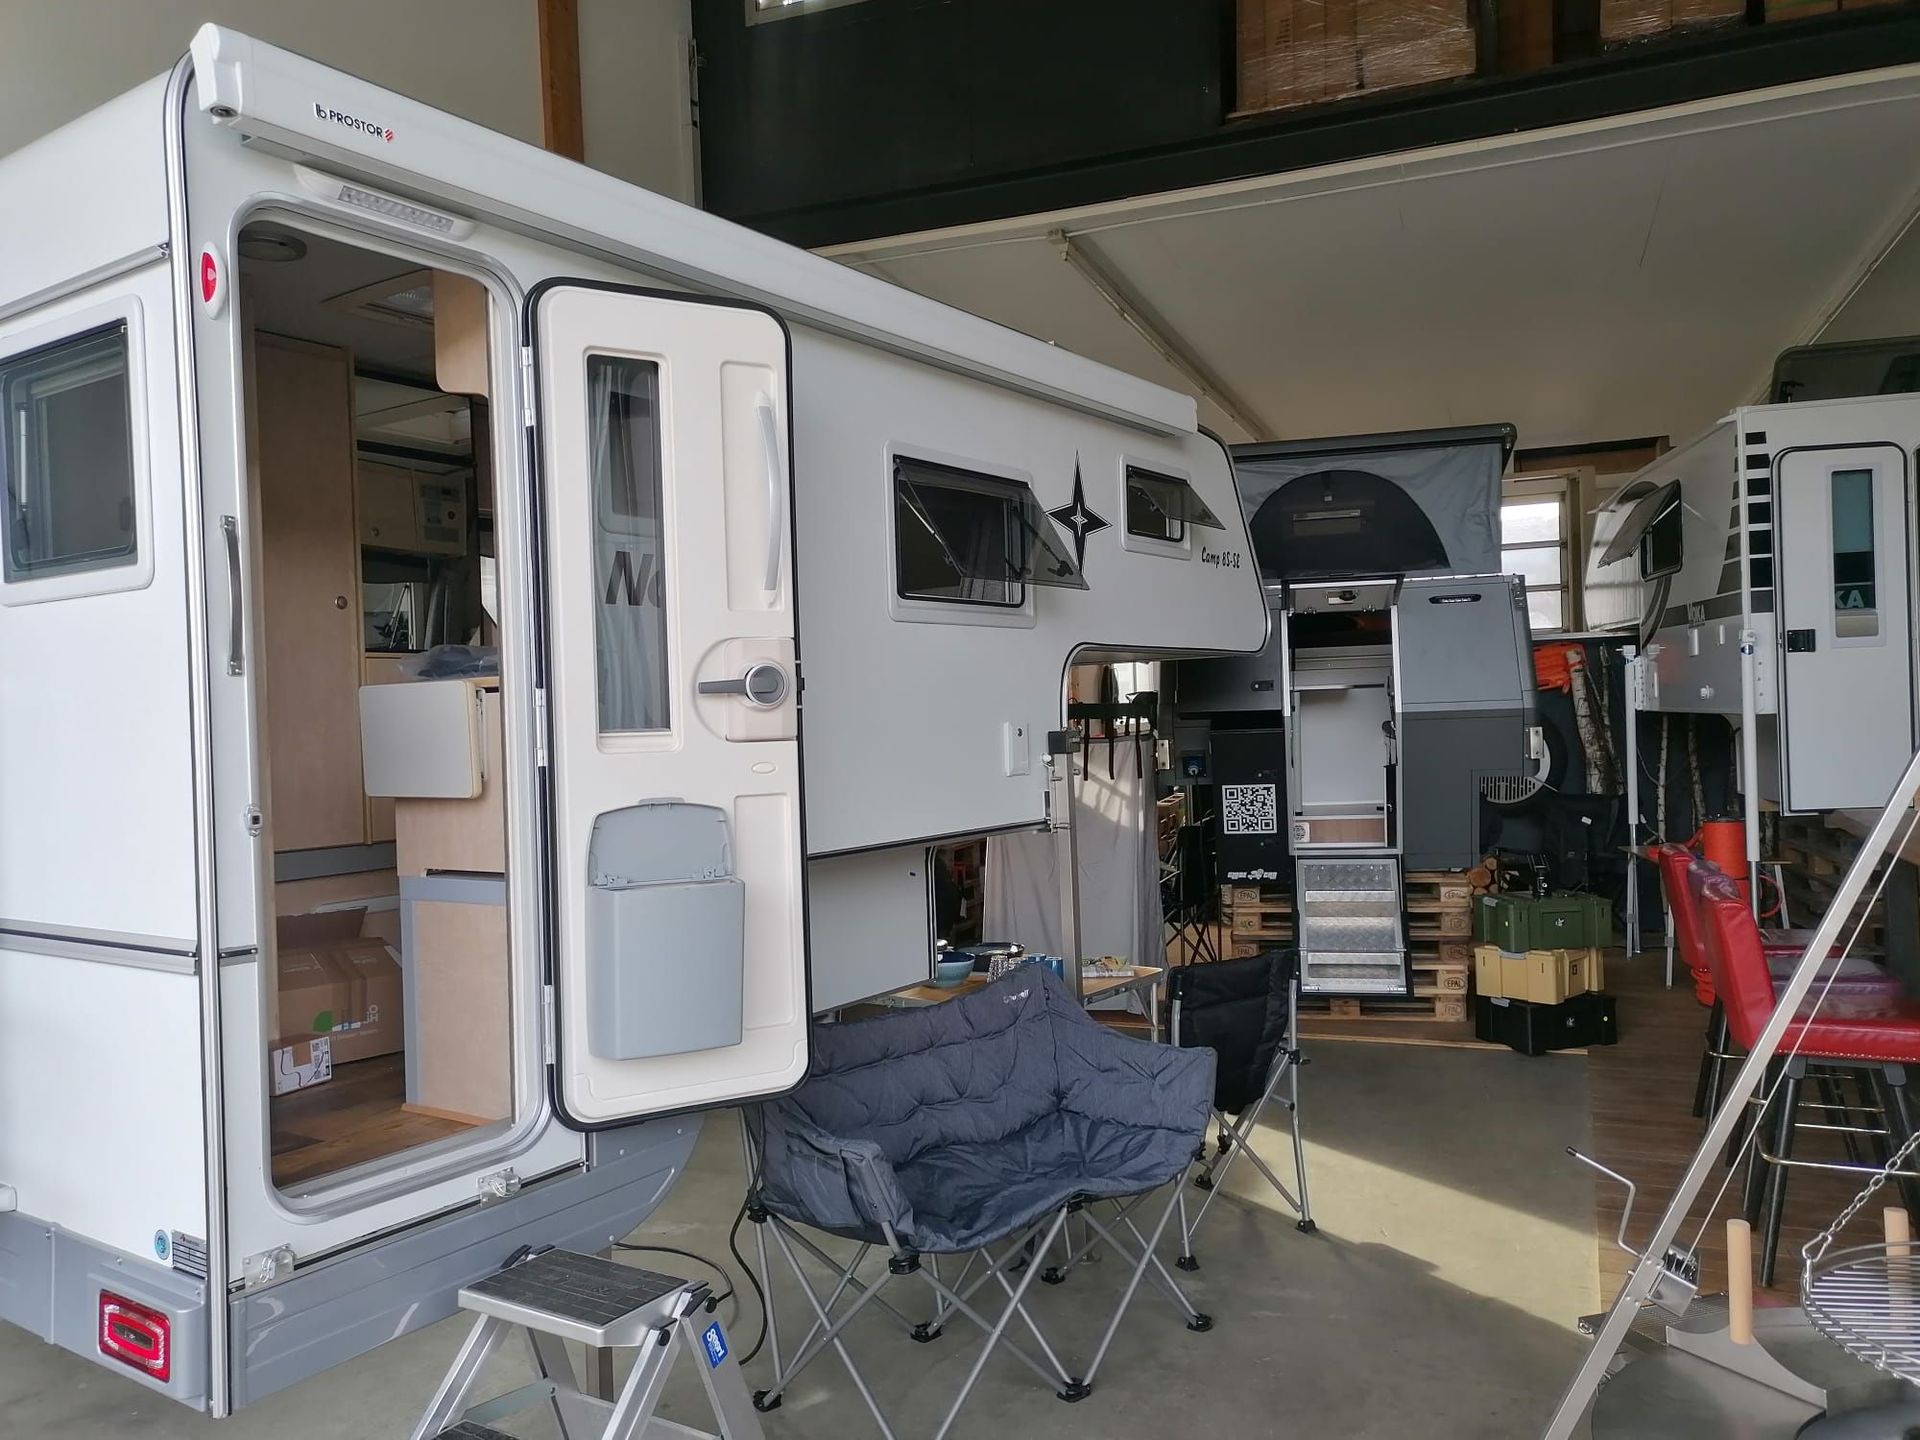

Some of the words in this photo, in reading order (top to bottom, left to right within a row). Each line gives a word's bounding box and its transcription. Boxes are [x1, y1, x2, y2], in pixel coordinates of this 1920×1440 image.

[329, 109, 383, 138] PROSTOR
[1202, 546, 1220, 569] Camp
[1447, 980, 1461, 988] EPAL
